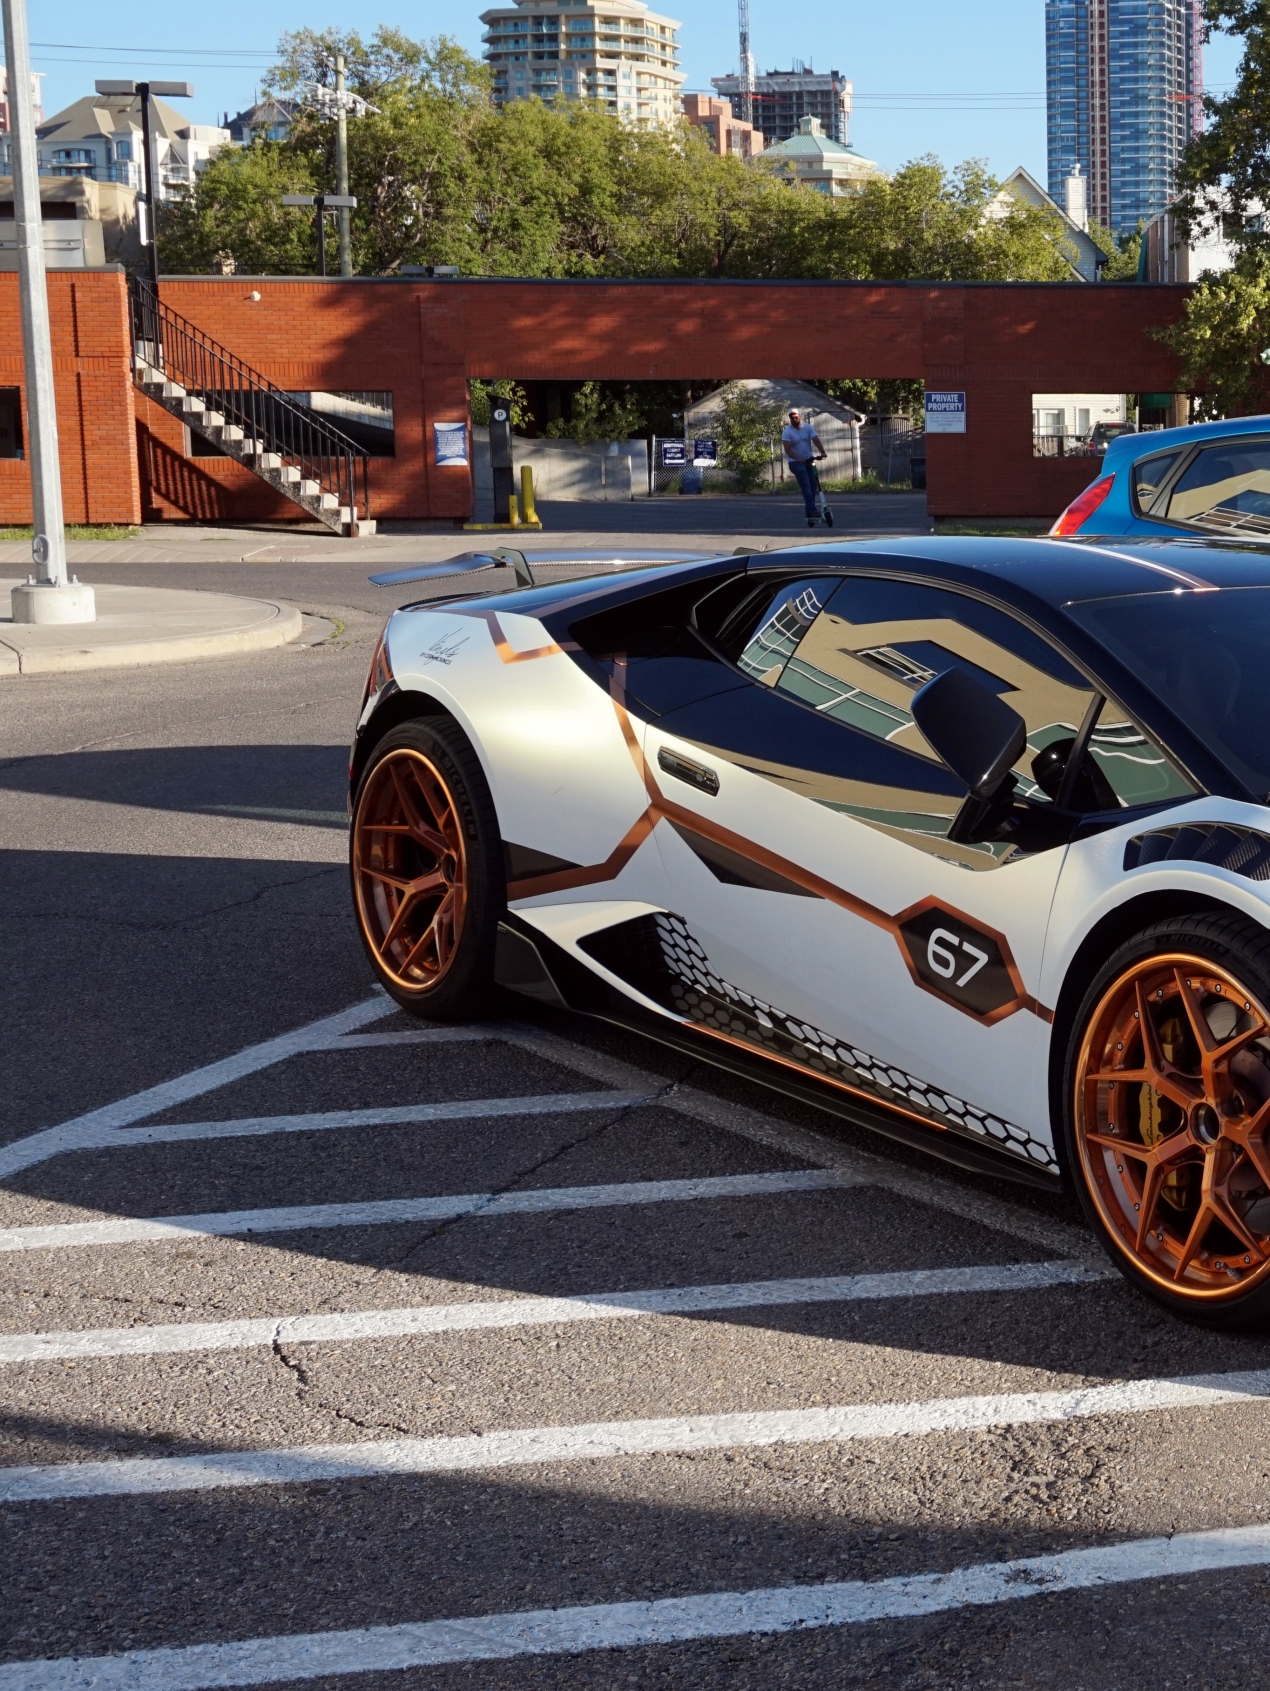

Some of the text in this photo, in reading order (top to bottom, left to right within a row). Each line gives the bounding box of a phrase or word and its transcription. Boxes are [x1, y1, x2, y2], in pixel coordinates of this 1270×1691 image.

[928, 403, 963, 411] PROPERTY
[932, 394, 959, 403] PRIVATE
[441, 756, 476, 836] MICHELIN
[927, 928, 988, 987] 67
[1169, 933, 1228, 955] MICHELIN
[1146, 1083, 1154, 1146] Lamborghini
